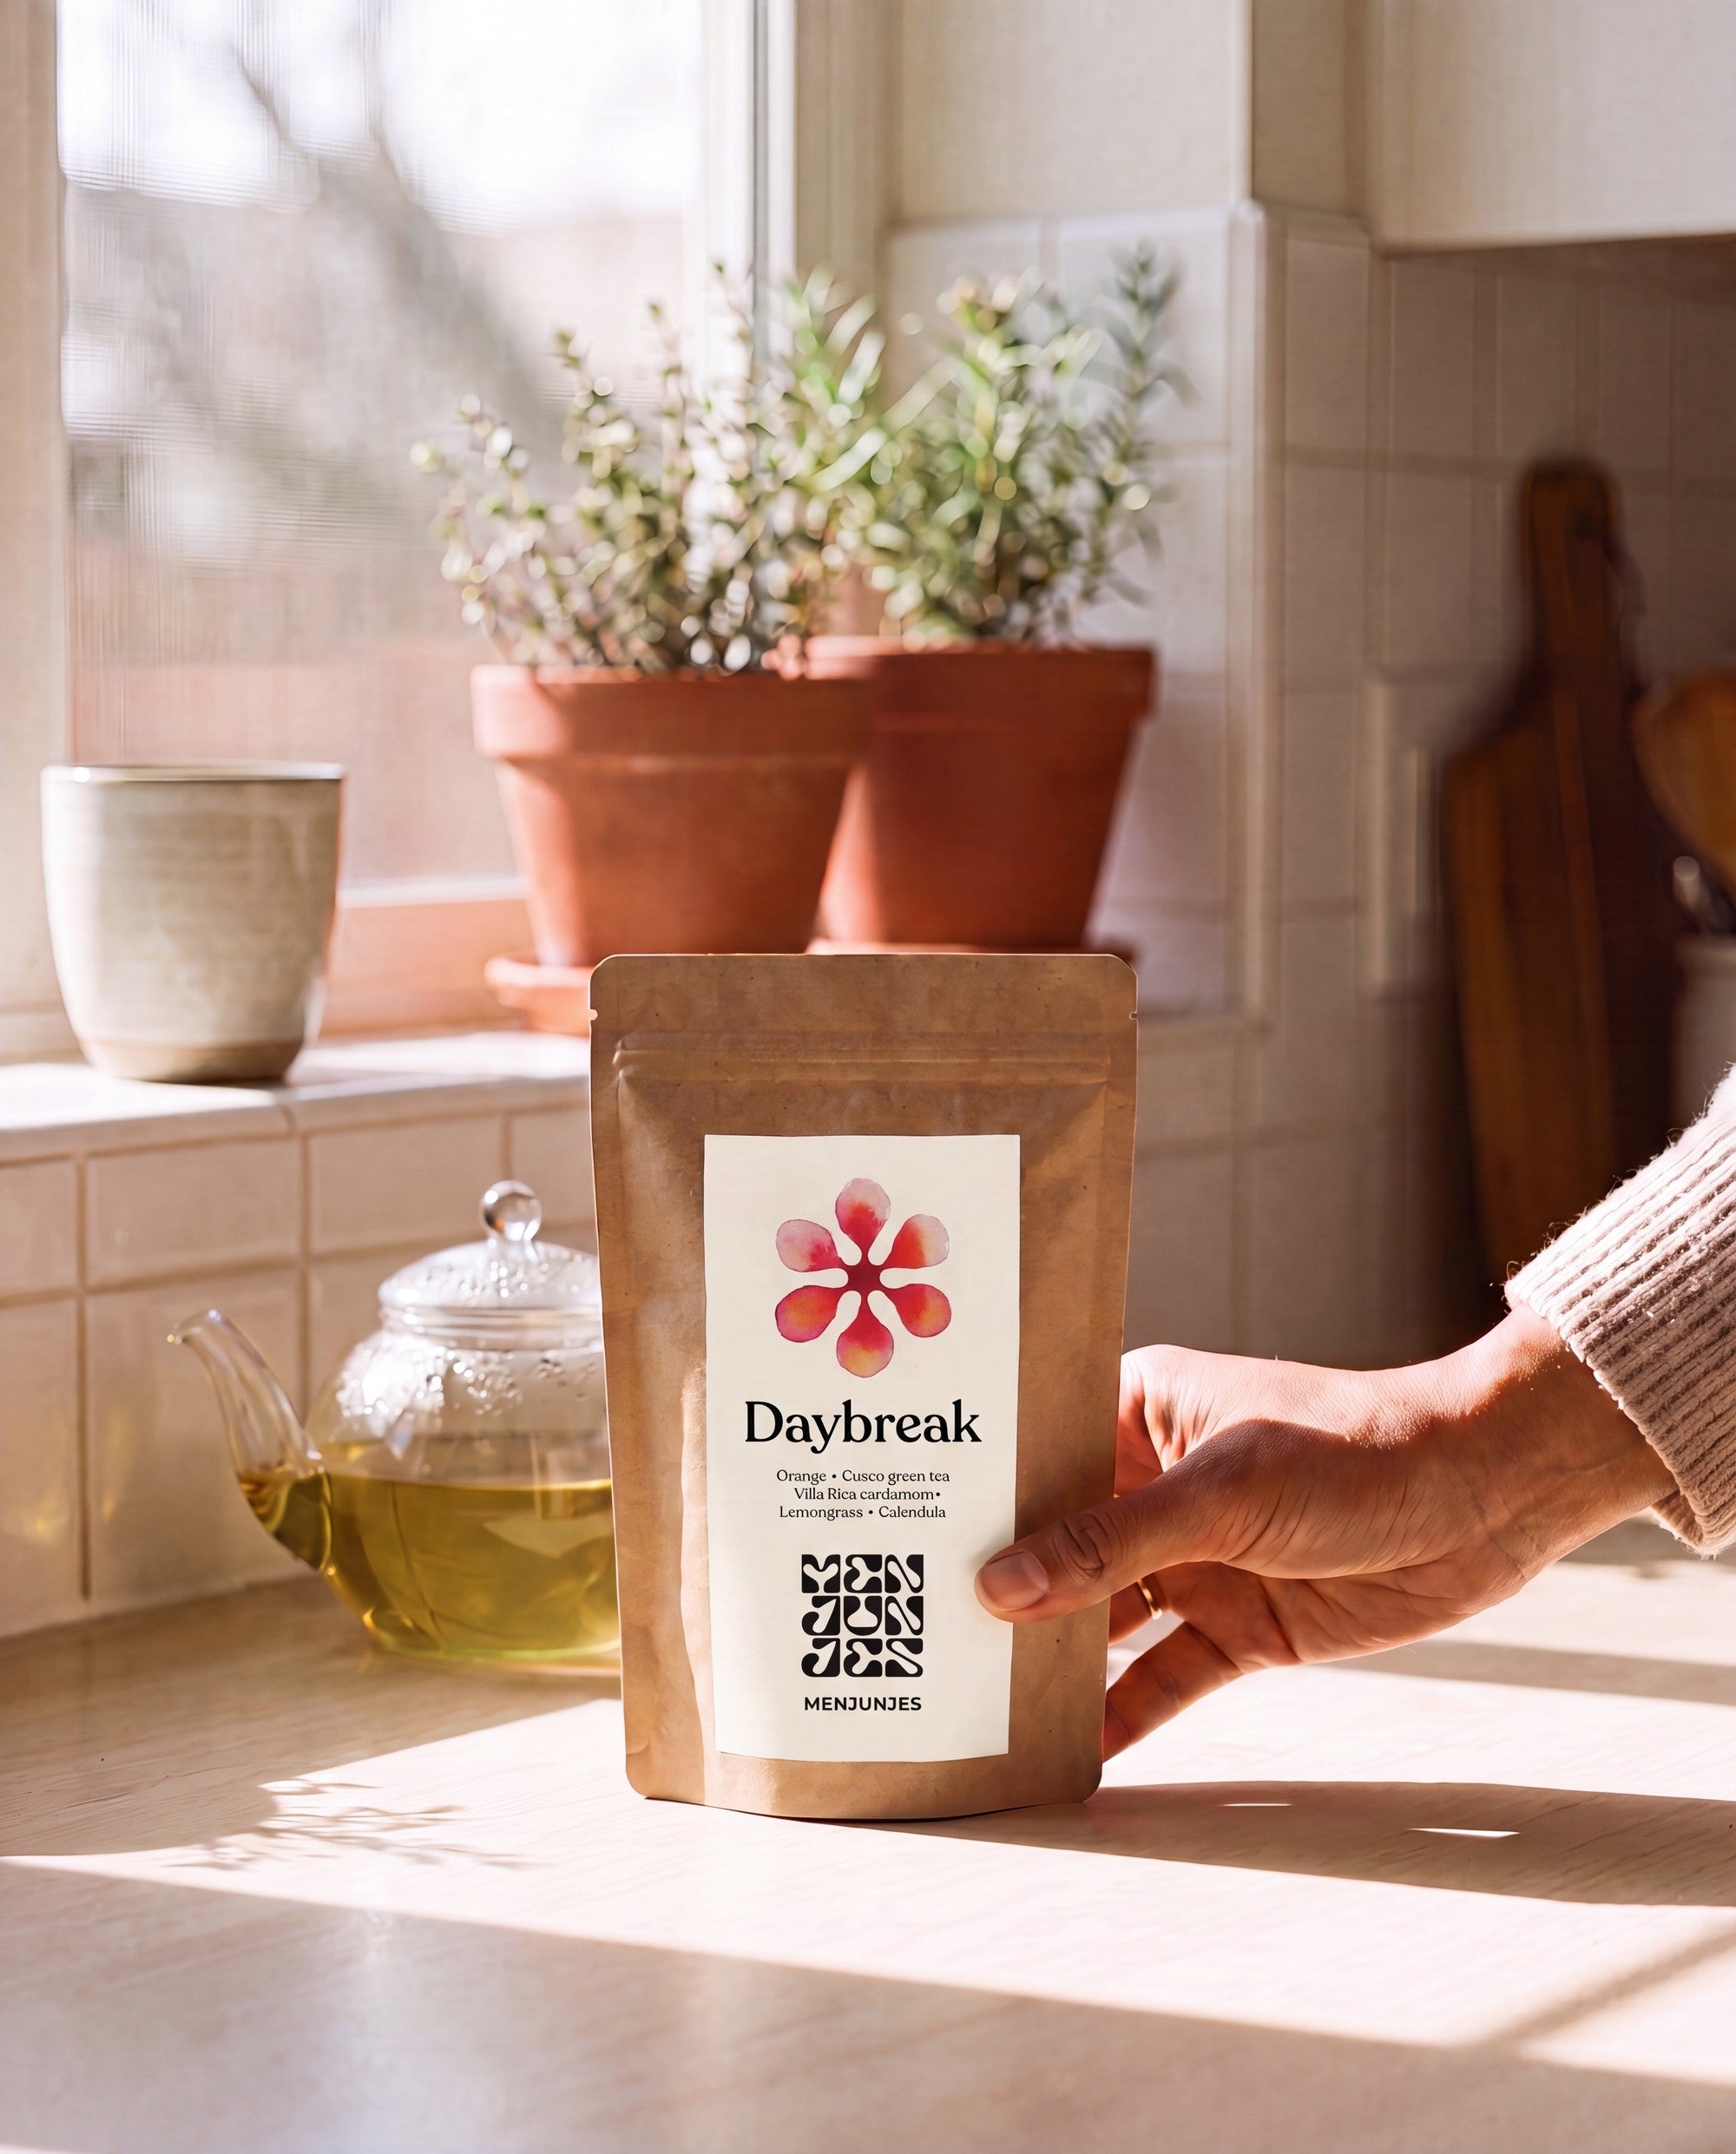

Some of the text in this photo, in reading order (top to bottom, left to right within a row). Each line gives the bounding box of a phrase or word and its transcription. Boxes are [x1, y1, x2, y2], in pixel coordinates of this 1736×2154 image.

[745, 1398, 983, 1455] Daybreak
[776, 1469, 950, 1486] Orange Cusco green tea
[793, 1487, 825, 1501] Villa
[827, 1487, 858, 1501] Rica
[779, 1505, 946, 1521] Lemongrass Calendula
[804, 1696, 922, 1711] MENJUNJES
